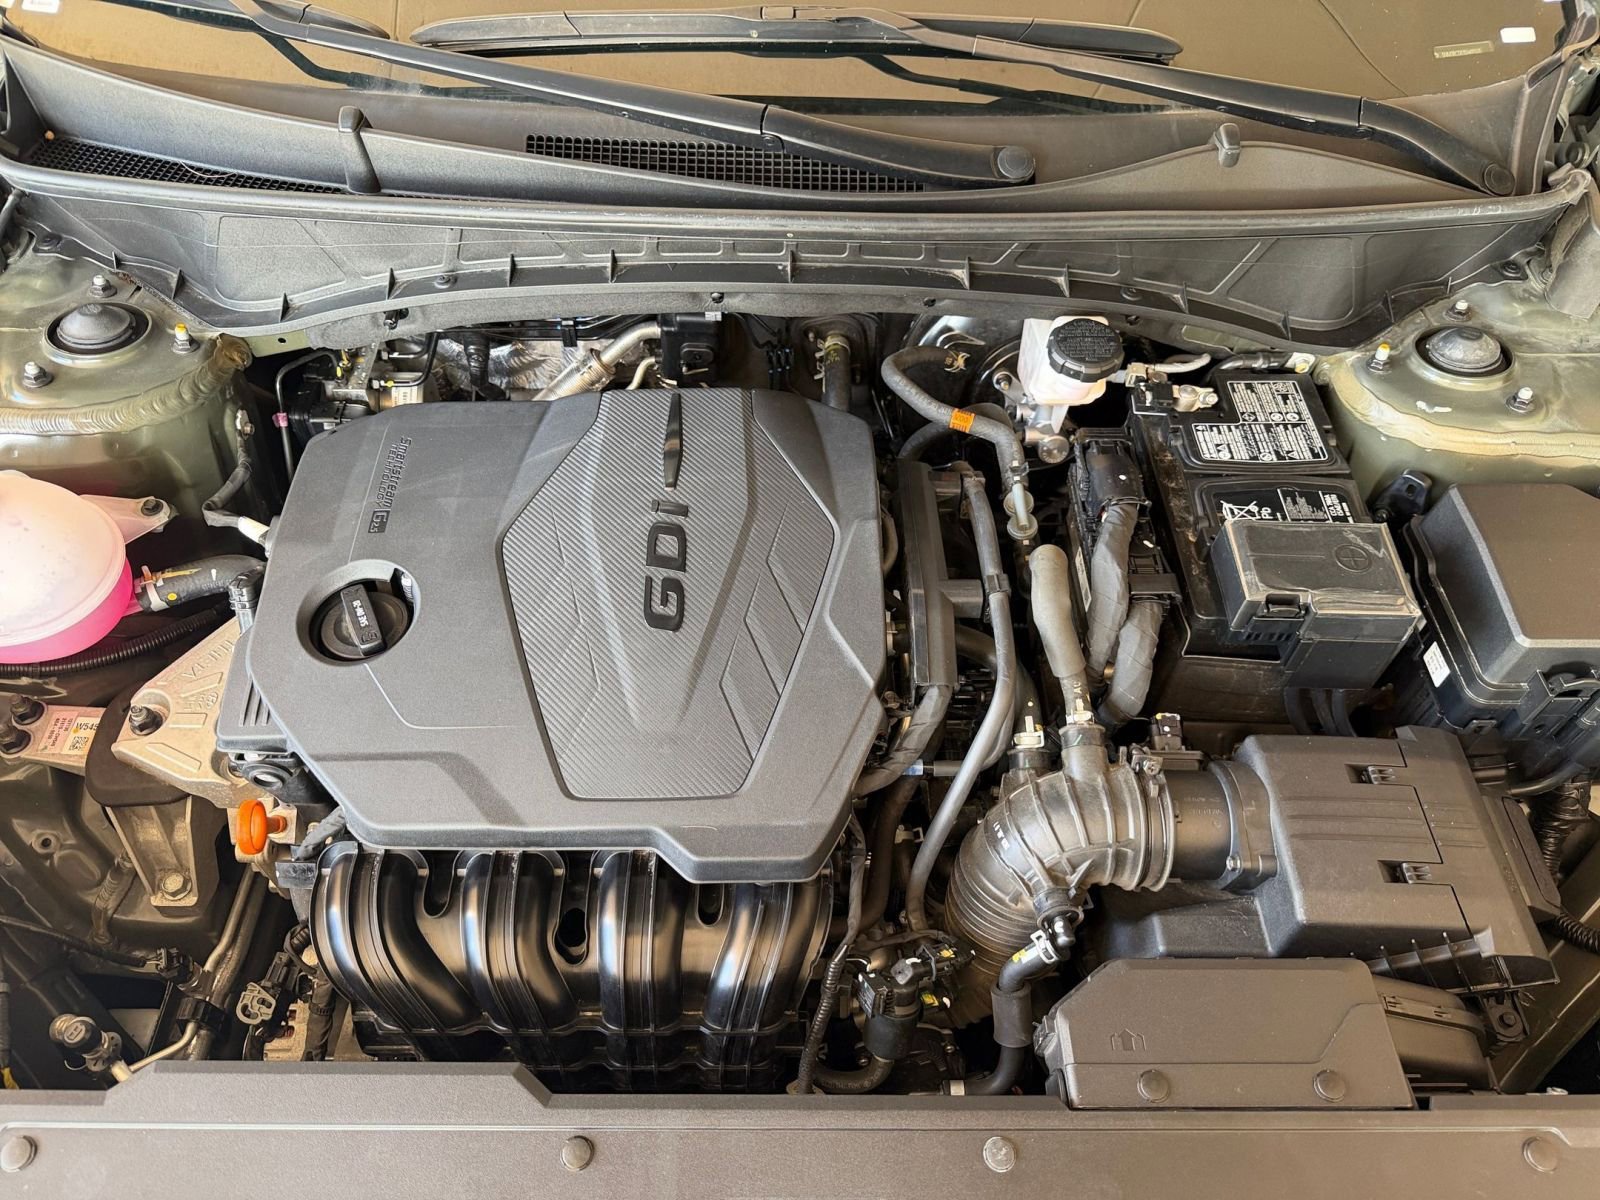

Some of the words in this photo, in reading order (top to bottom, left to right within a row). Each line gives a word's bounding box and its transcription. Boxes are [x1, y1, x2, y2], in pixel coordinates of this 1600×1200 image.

[375, 443, 398, 508] TECHNOLOGY
[384, 436, 412, 508] Smartstream
[1260, 506, 1274, 520] Pb
[643, 499, 689, 633] GDi
